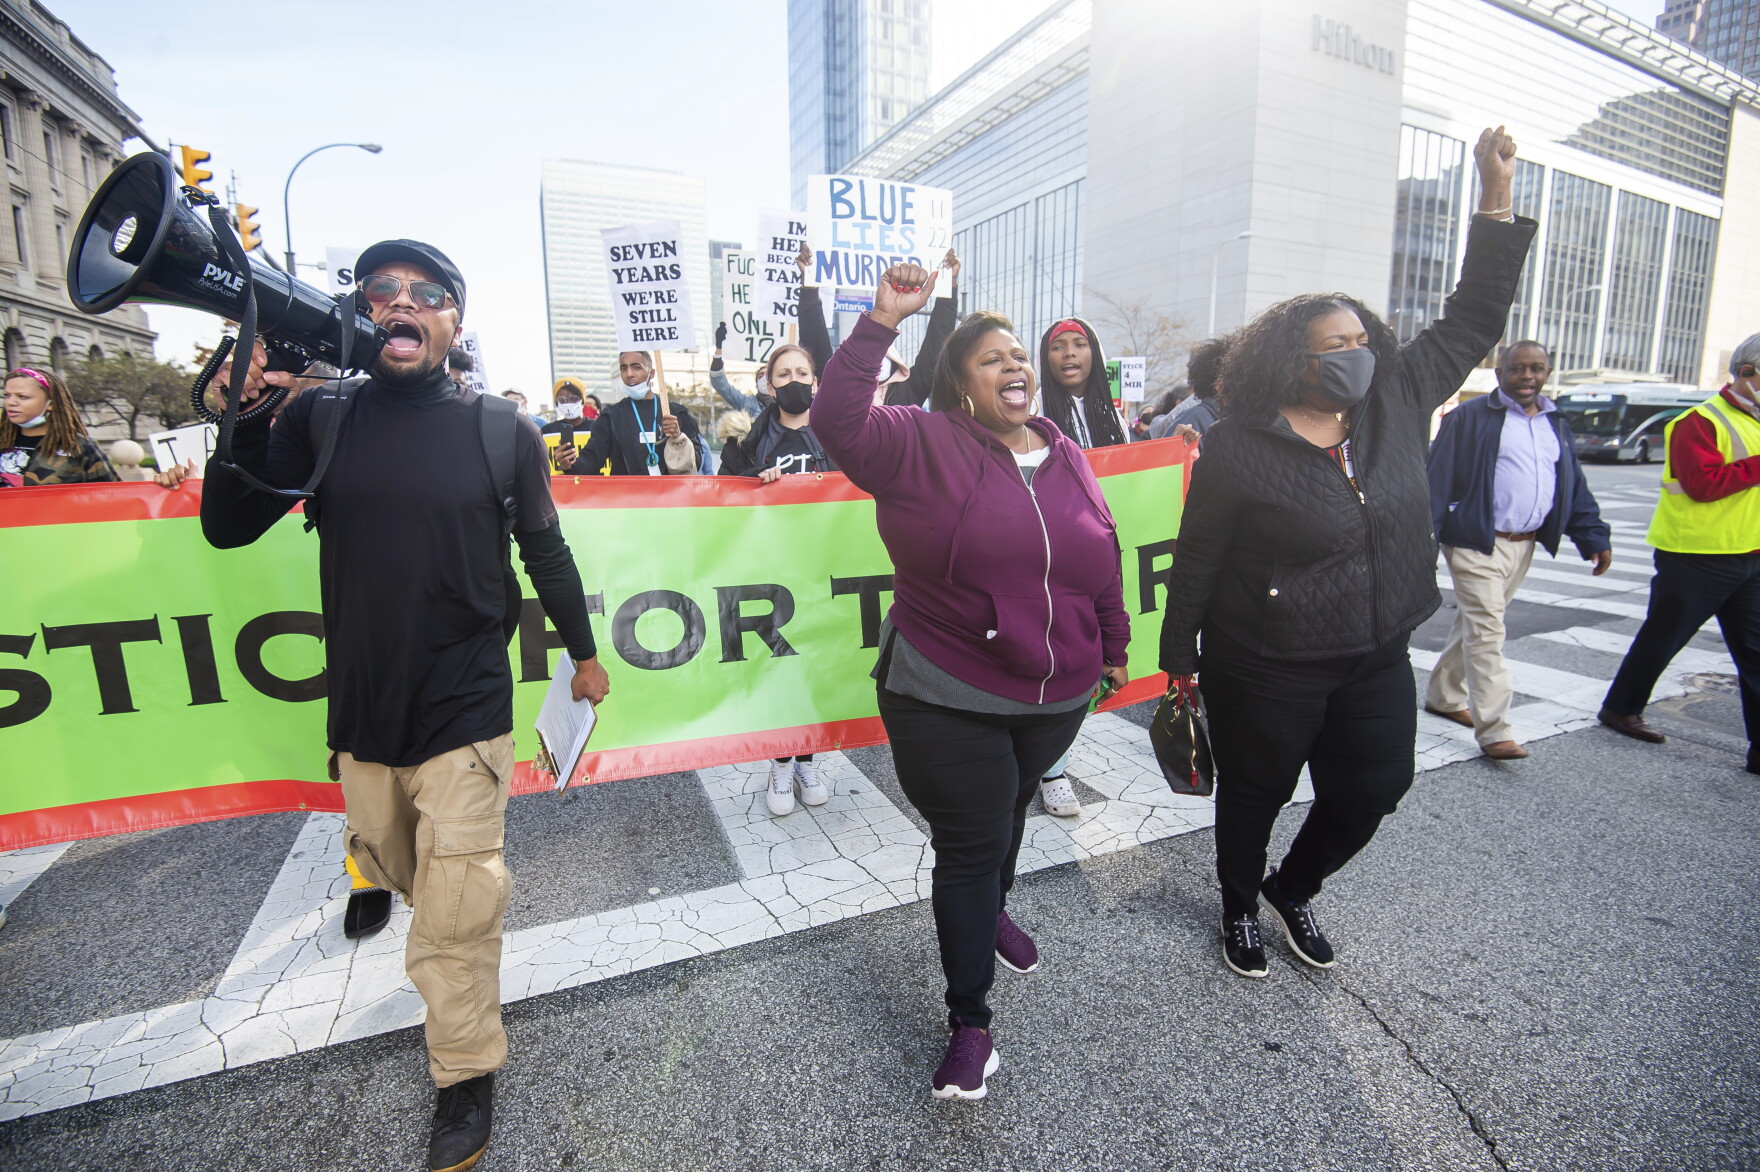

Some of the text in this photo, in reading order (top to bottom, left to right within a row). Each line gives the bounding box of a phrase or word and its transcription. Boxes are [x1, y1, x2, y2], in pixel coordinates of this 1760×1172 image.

[1311, 14, 1395, 76] Hilton
[830, 178, 915, 225] BLUE
[832, 221, 916, 254] LIES
[610, 240, 677, 262] SEVEN
[612, 263, 681, 284] YEARS
[815, 250, 922, 287] MURD
[621, 289, 678, 306] WE'RE
[833, 301, 867, 311] Ontario
[629, 308, 677, 324] STILL
[632, 326, 679, 342] HERE
[745, 336, 775, 363] 12
[517, 583, 800, 683] FOR
